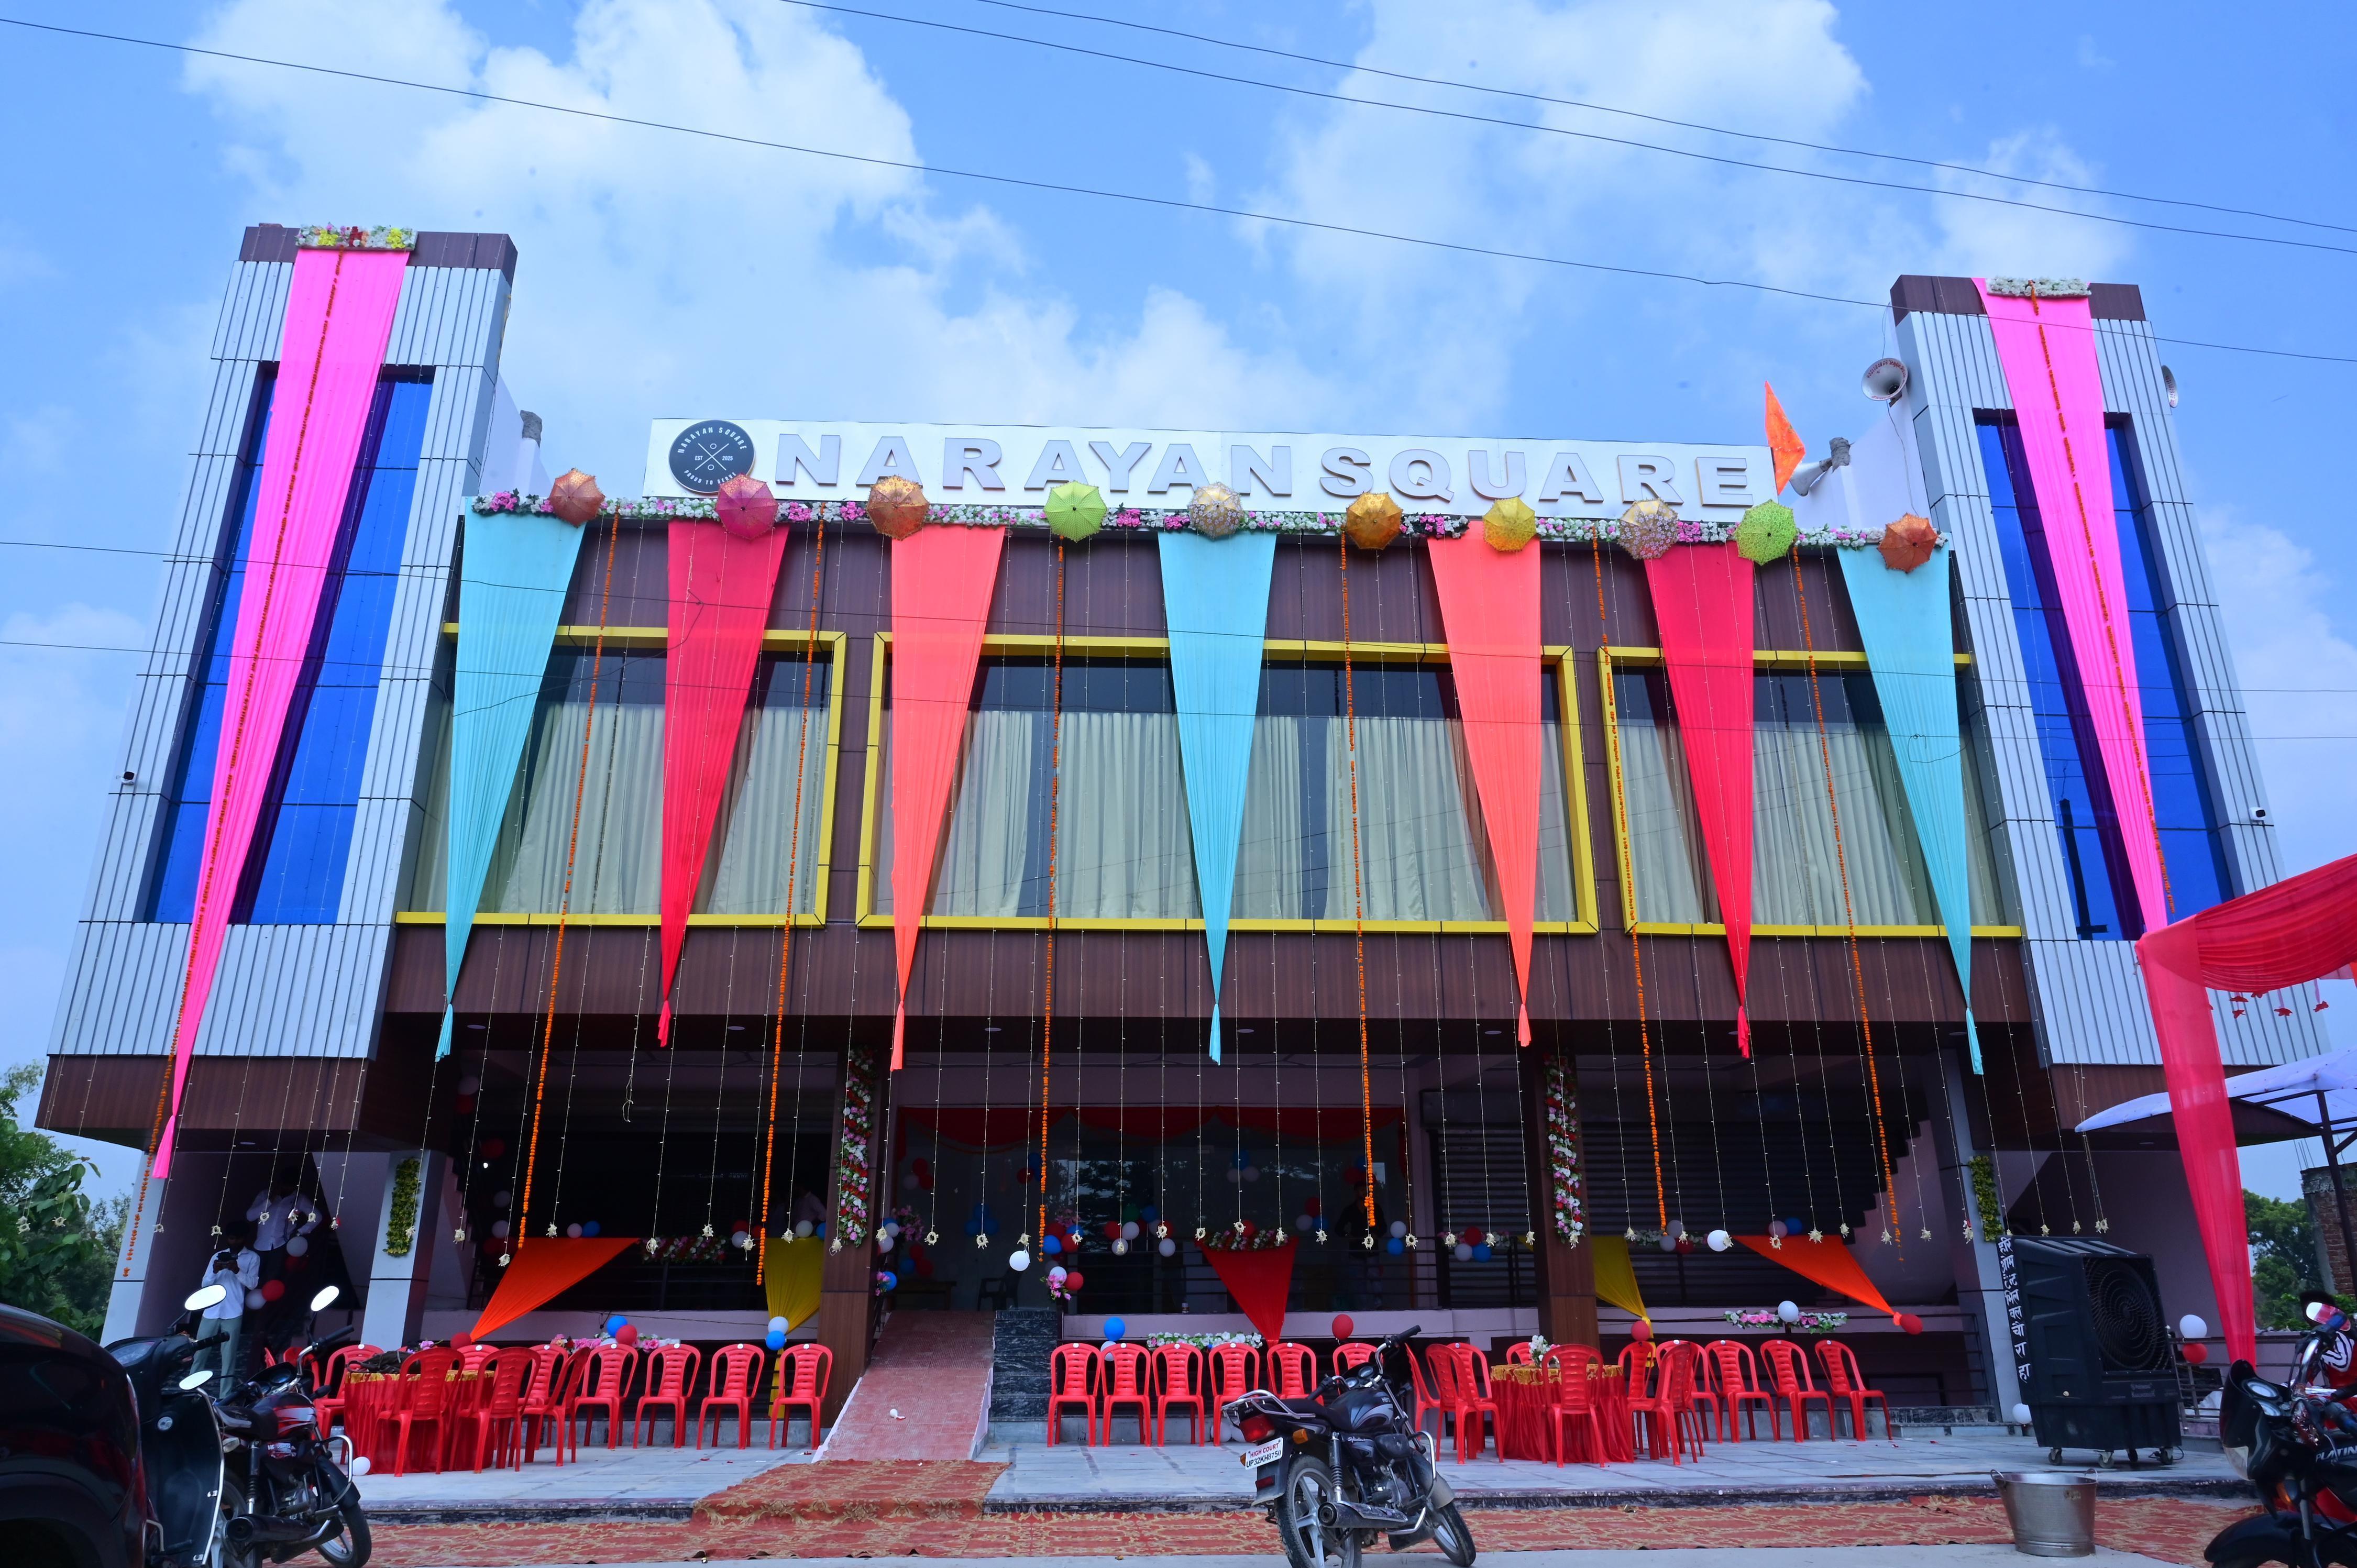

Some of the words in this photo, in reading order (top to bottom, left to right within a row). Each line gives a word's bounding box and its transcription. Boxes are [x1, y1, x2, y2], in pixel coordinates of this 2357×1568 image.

[678, 427, 713, 454] NARAYAN
[719, 427, 747, 450] SQUARE
[684, 470, 702, 483] PROUD
[775, 433, 1292, 496] NARAYAN
[1319, 447, 1754, 507] SQUARE
[1246, 1450, 1281, 1468] UP32KH8750
[1250, 1449, 1262, 1458] HIGH
[1262, 1443, 1279, 1453] COURT
